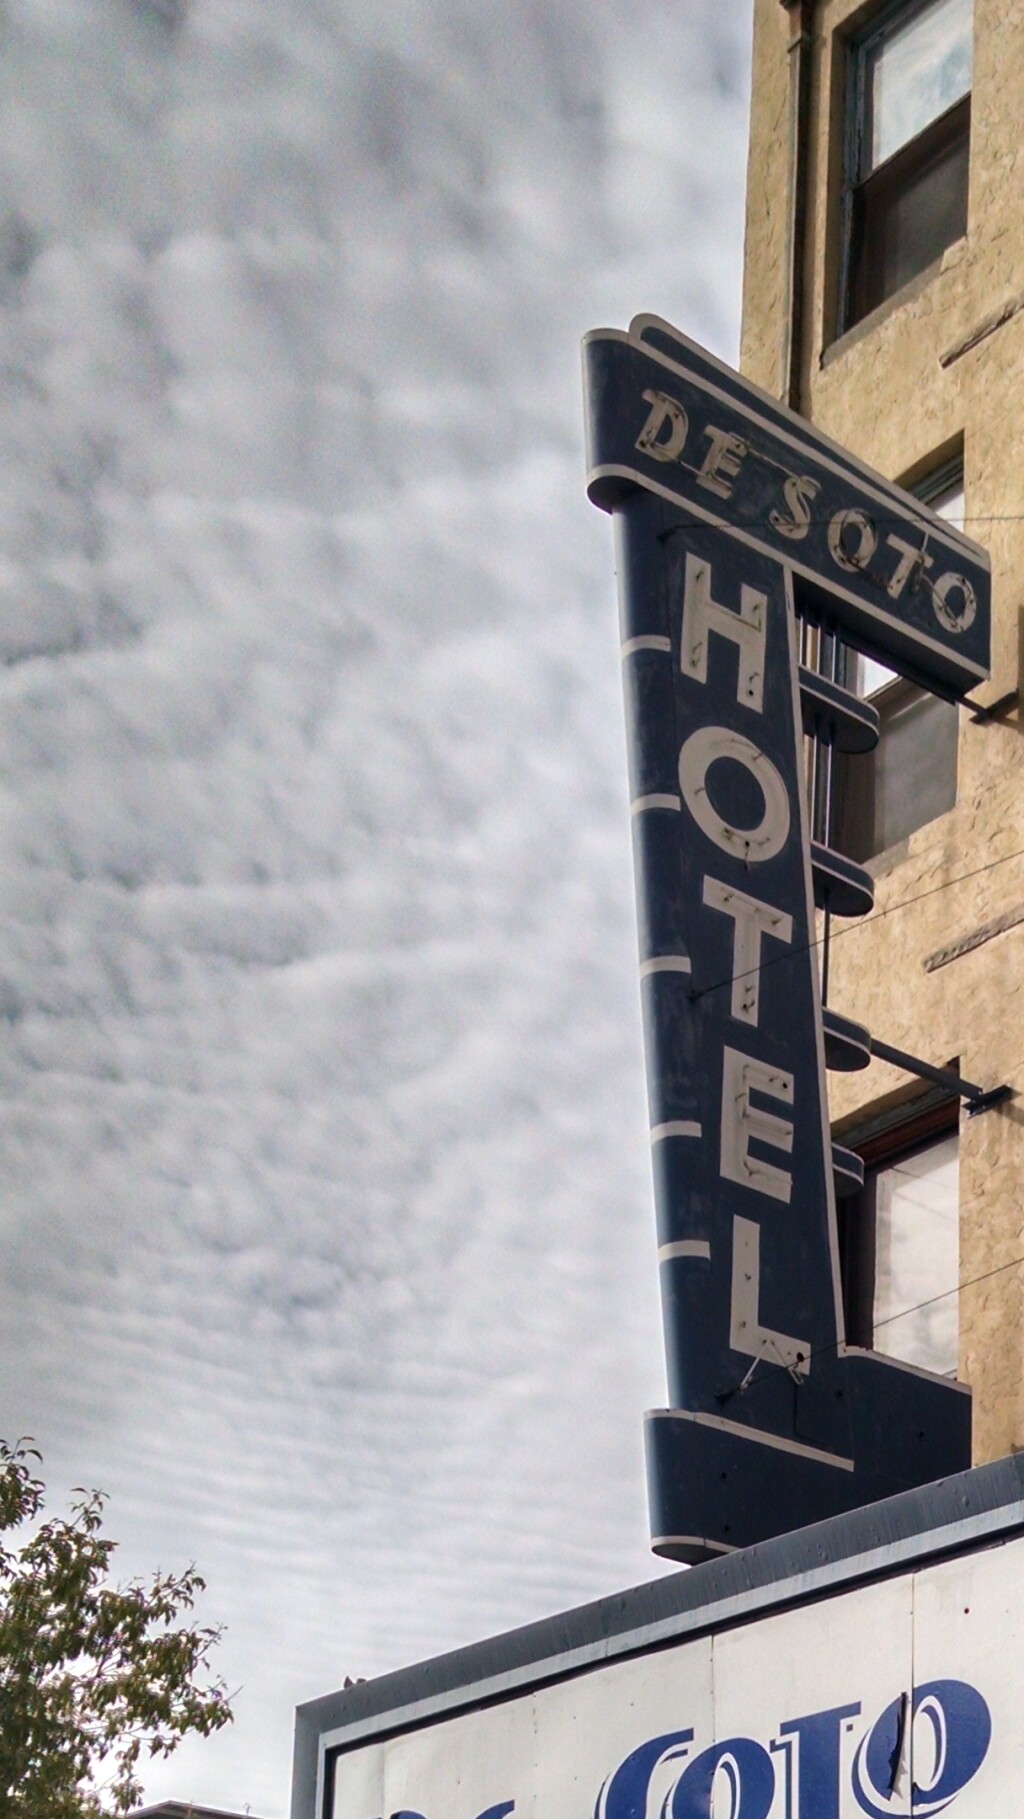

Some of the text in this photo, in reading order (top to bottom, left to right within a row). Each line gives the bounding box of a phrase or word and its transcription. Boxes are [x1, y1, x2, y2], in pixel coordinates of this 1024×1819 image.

[635, 389, 977, 633] DE SOTO
[678, 551, 811, 1375] HOTEL
